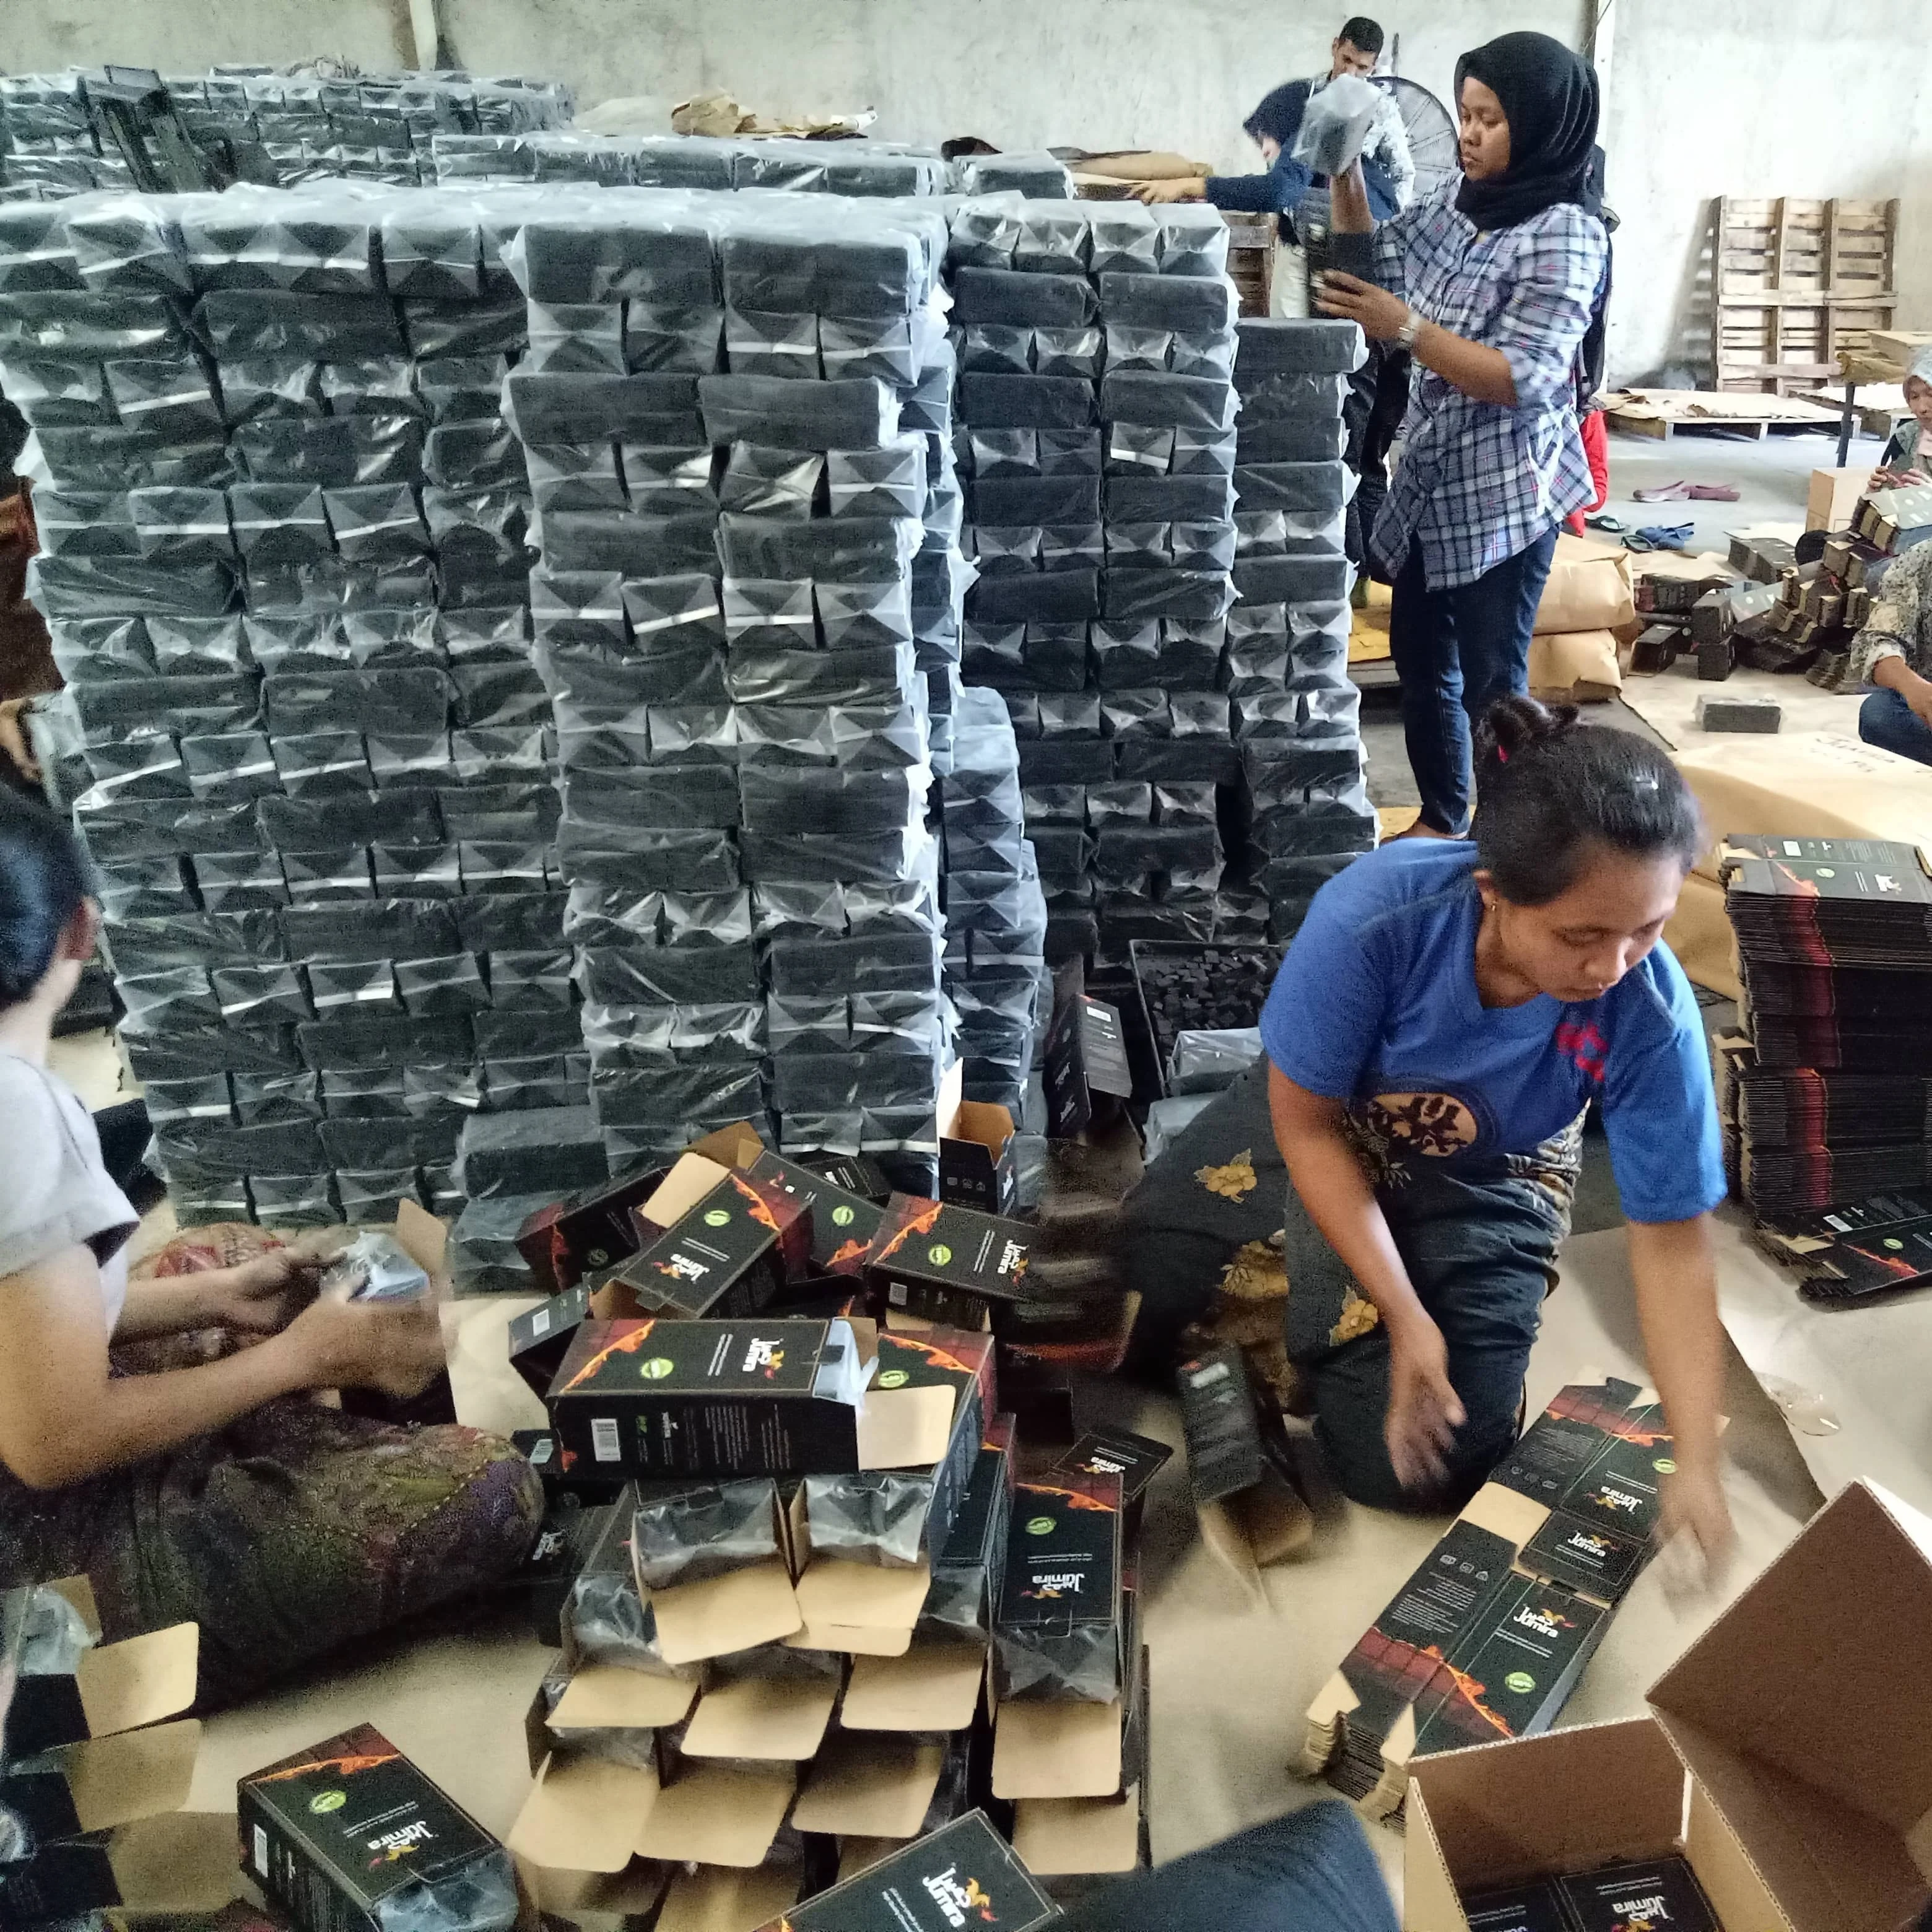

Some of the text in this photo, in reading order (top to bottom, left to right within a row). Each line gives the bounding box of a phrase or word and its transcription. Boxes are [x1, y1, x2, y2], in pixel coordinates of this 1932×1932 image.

[671, 1254, 710, 1281] Jumira
[998, 1240, 1027, 1274] Jumira
[742, 1338, 780, 1372] Jumira
[1601, 1486, 1643, 1512] Jumira
[1567, 1533, 1606, 1557] Jumira
[1032, 1573, 1085, 1591] Jumira
[1513, 1607, 1558, 1637] Jumira
[368, 1821, 433, 1850] Jumira
[923, 1867, 965, 1927] Jumira
[1612, 1895, 1669, 1919] Jumira
